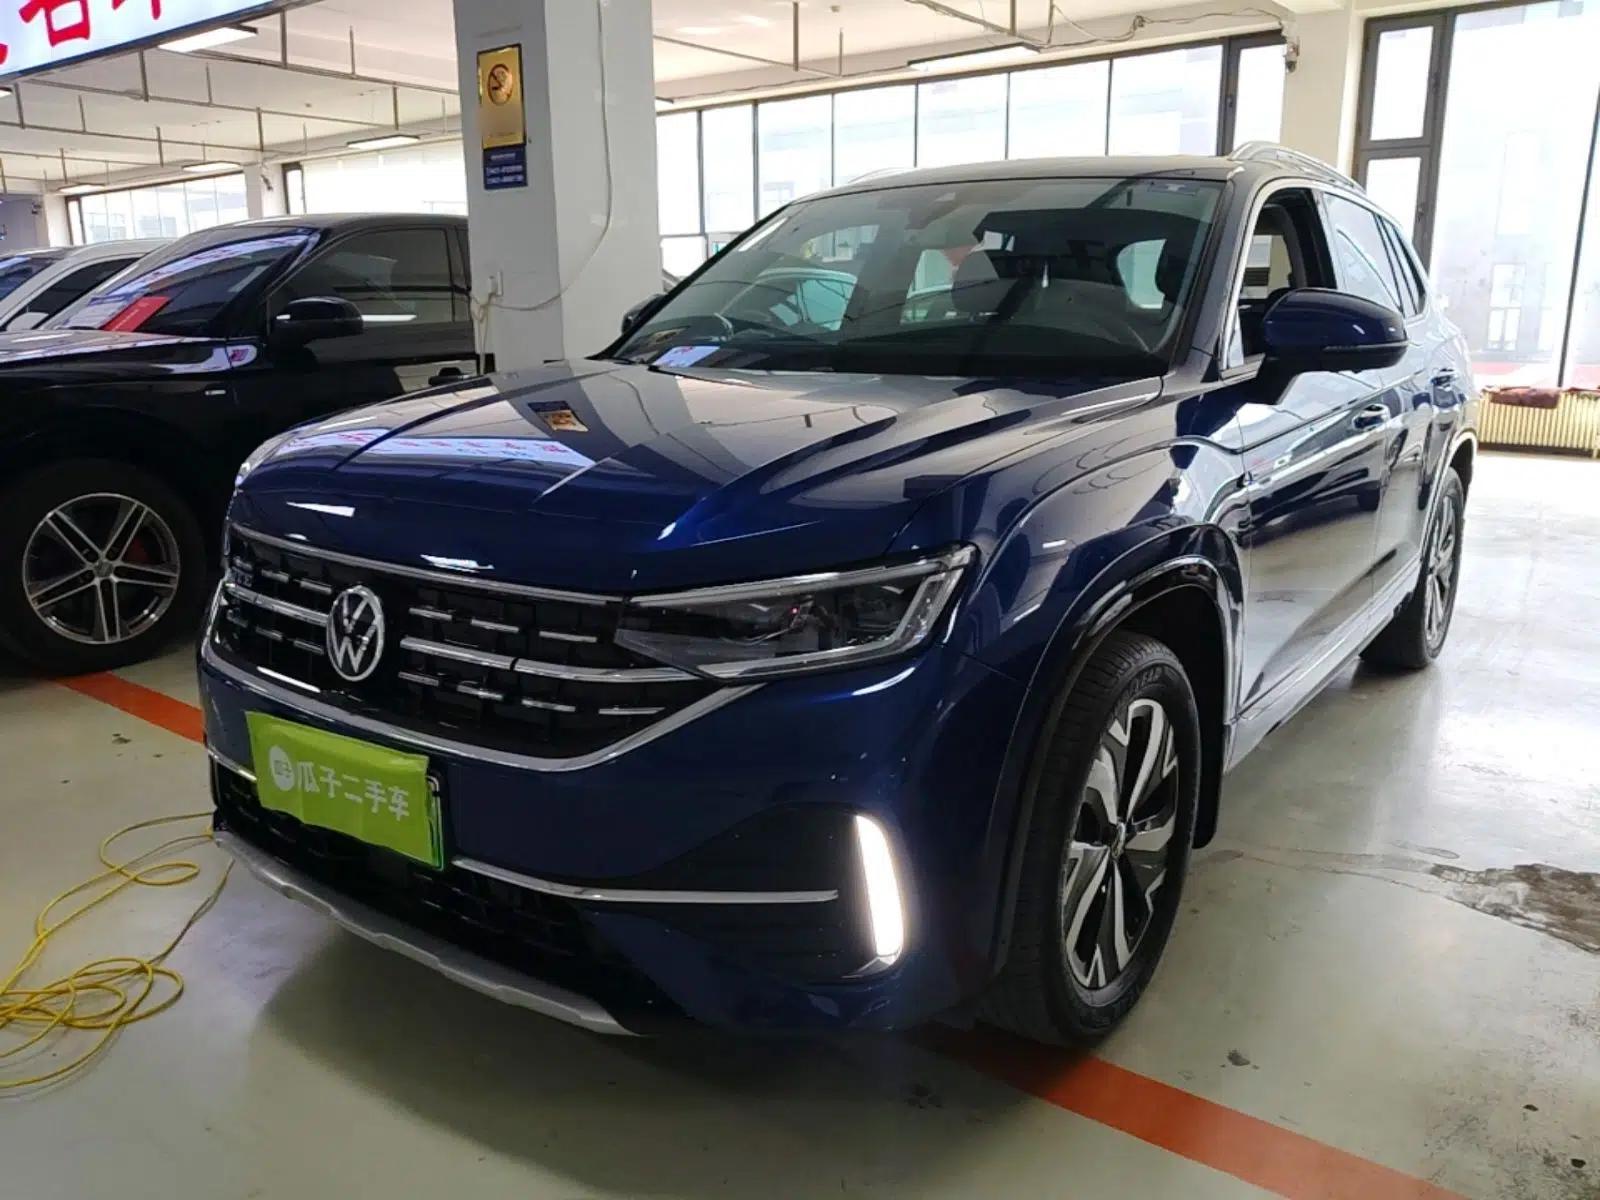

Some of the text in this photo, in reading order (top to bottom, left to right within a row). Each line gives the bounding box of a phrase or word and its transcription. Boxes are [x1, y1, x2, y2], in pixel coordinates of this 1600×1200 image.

[296, 761, 410, 822] 瓜子二手车
